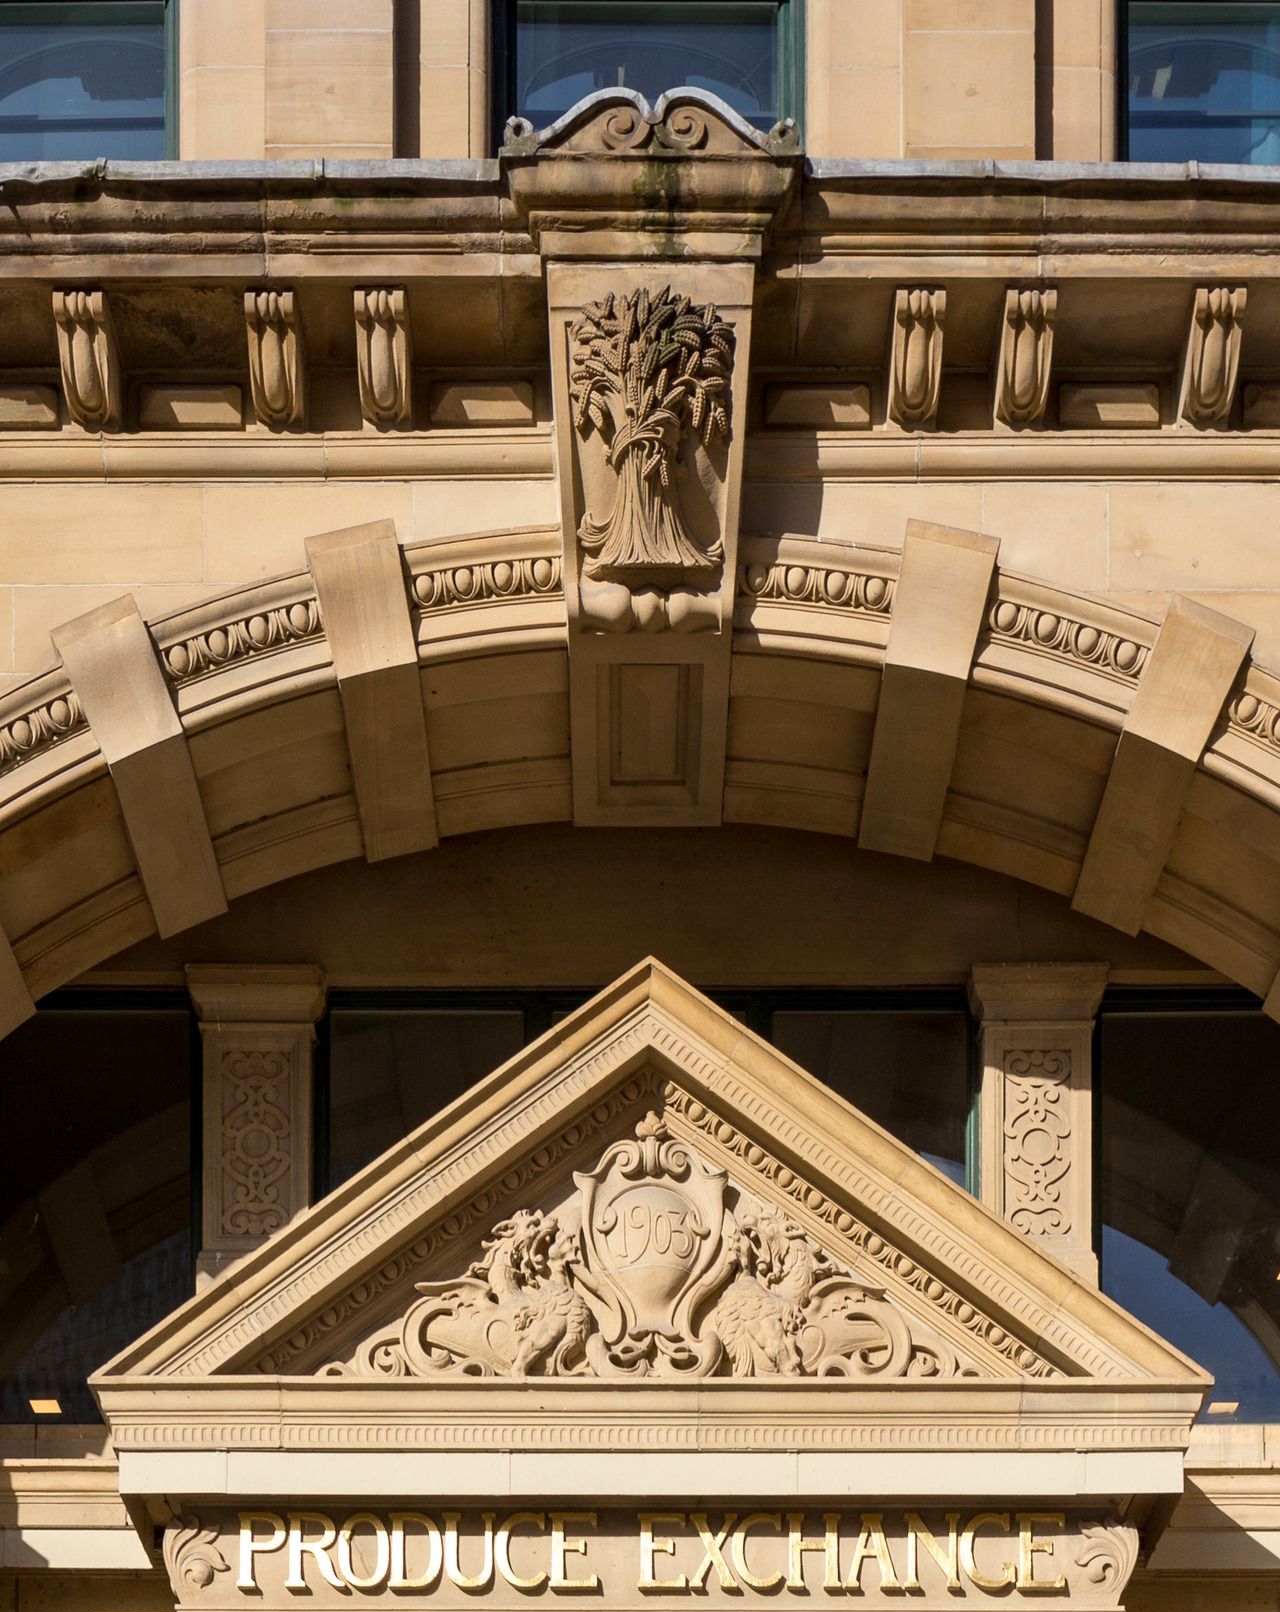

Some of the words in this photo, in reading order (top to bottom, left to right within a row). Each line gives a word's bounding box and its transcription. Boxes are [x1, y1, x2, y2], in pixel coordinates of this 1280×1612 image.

[616, 1204, 694, 1264] 1903
[236, 1512, 599, 1592] PRODUCE
[637, 1513, 1067, 1592] EXCHANGE
